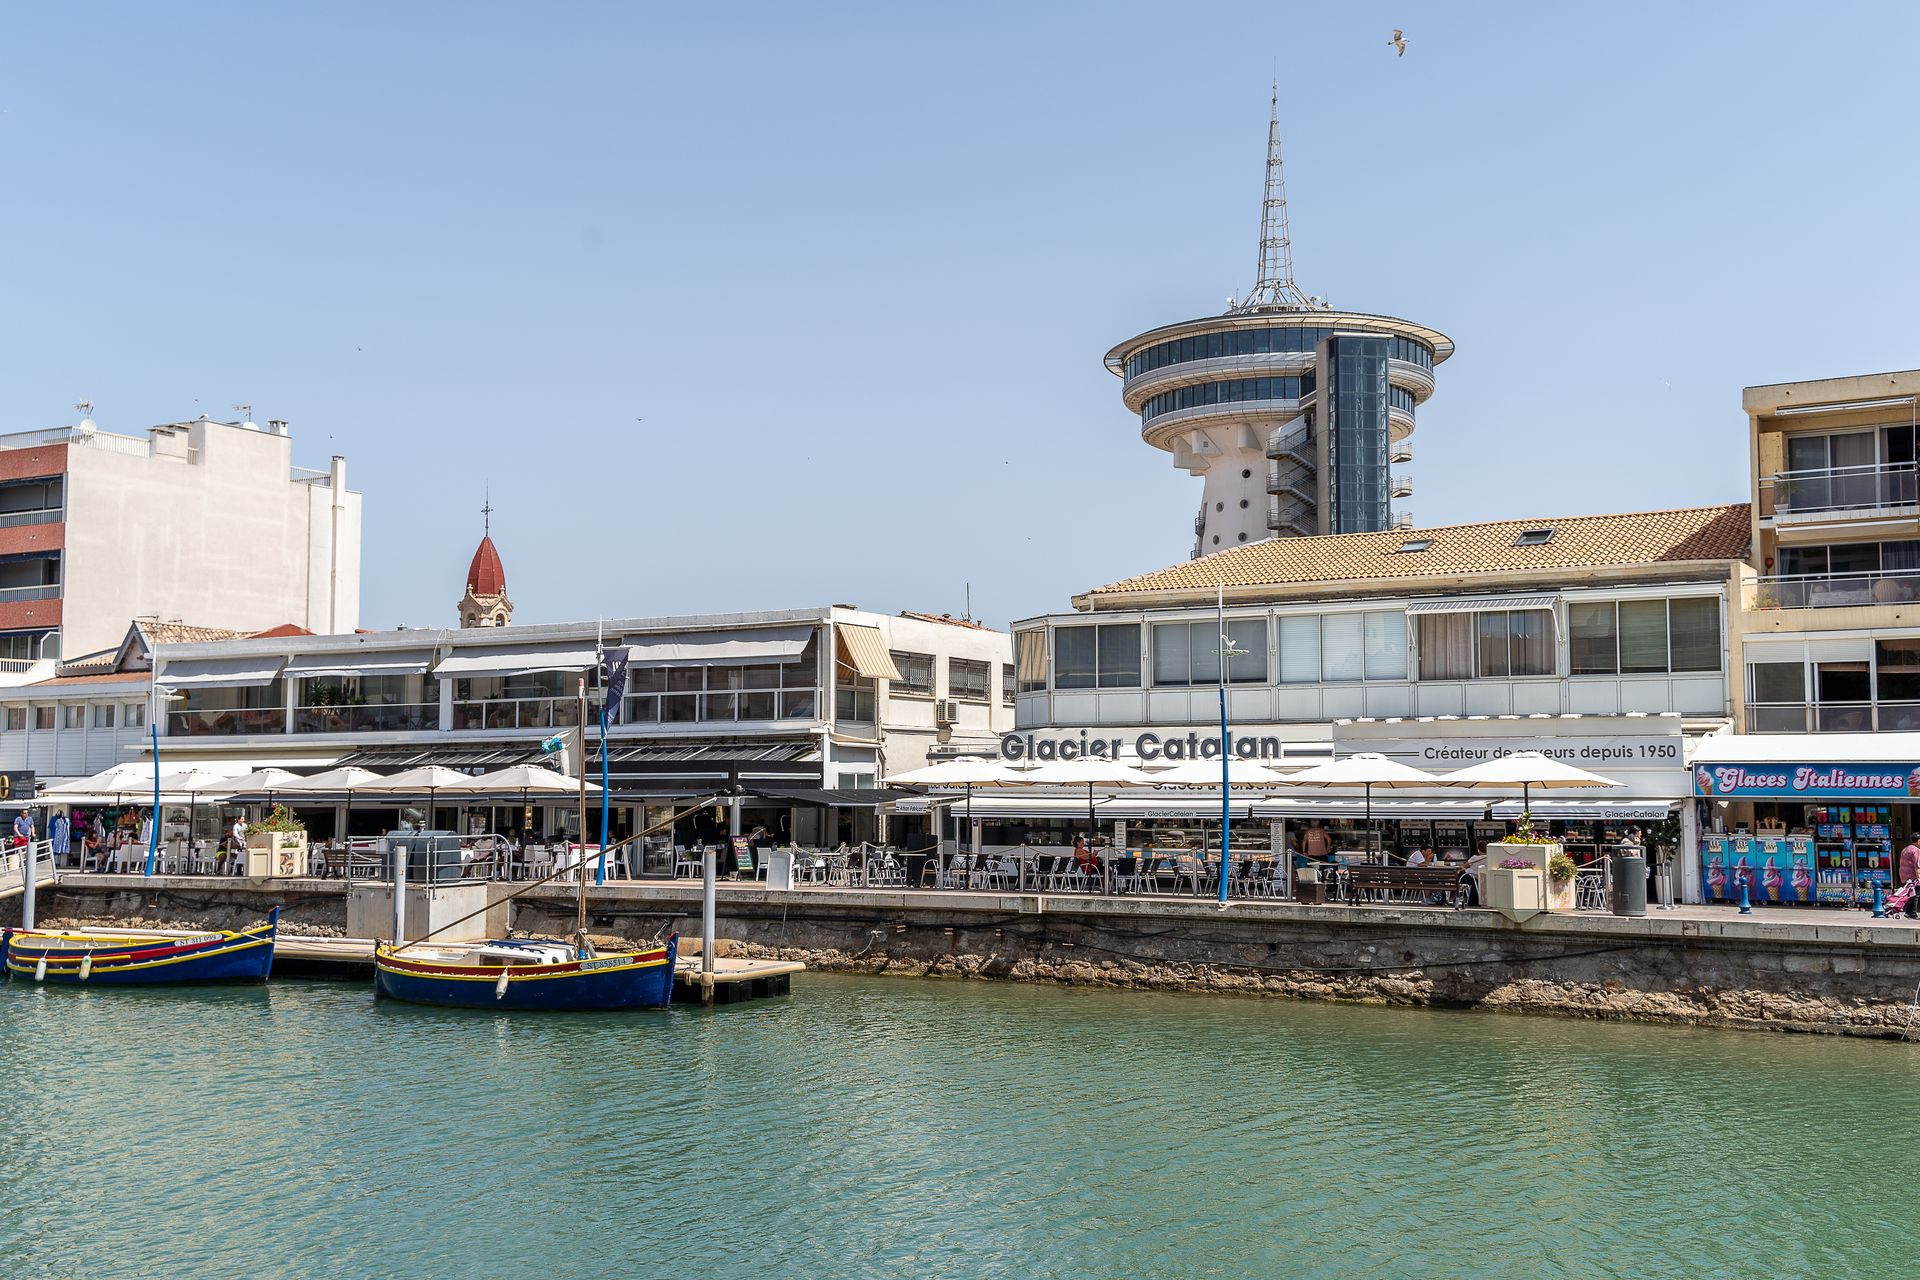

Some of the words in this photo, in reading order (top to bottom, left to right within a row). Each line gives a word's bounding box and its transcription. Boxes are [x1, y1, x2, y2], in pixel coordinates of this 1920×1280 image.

[1001, 729, 1123, 761] Glacier
[1136, 731, 1281, 760] Catalan
[1424, 745, 1488, 760] Créateur
[1493, 746, 1512, 759] de
[1517, 749, 1575, 759] eurs
[1580, 745, 1634, 762] depuis
[1640, 744, 1677, 758] 1950
[1715, 767, 1788, 793] Glaces
[1792, 767, 1904, 791] Italiennes
[1604, 810, 1665, 818] GlacierCatalan
